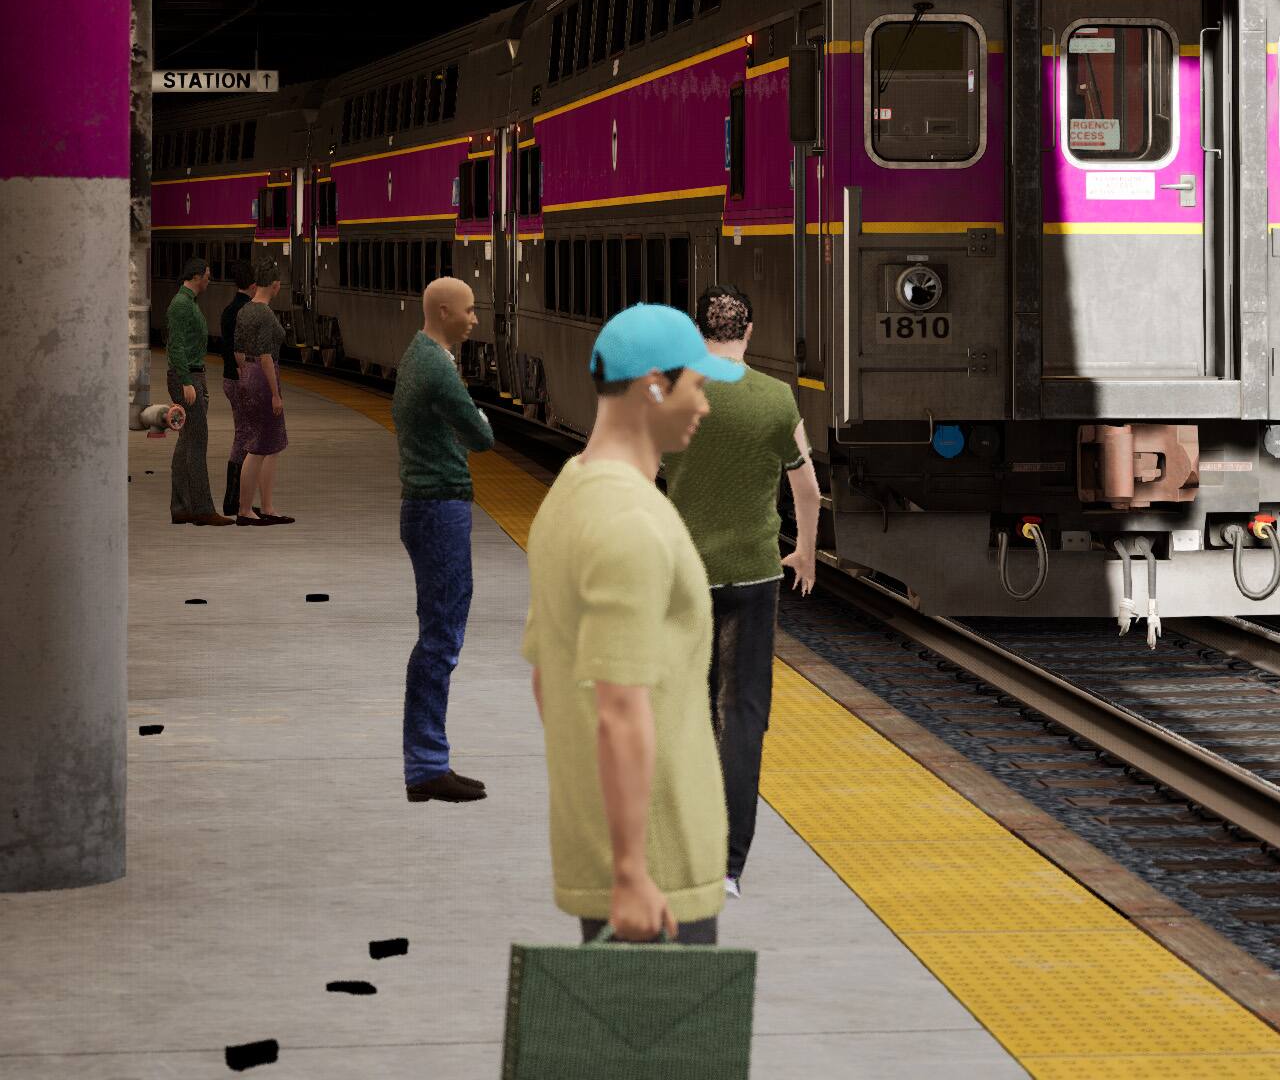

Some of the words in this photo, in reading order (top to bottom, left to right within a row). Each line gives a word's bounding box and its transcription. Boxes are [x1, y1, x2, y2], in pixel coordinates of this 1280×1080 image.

[163, 72, 251, 89] STATION
[1072, 120, 1116, 130] RGENCY
[1071, 131, 1105, 140] CCESS
[880, 316, 950, 338] 1810
